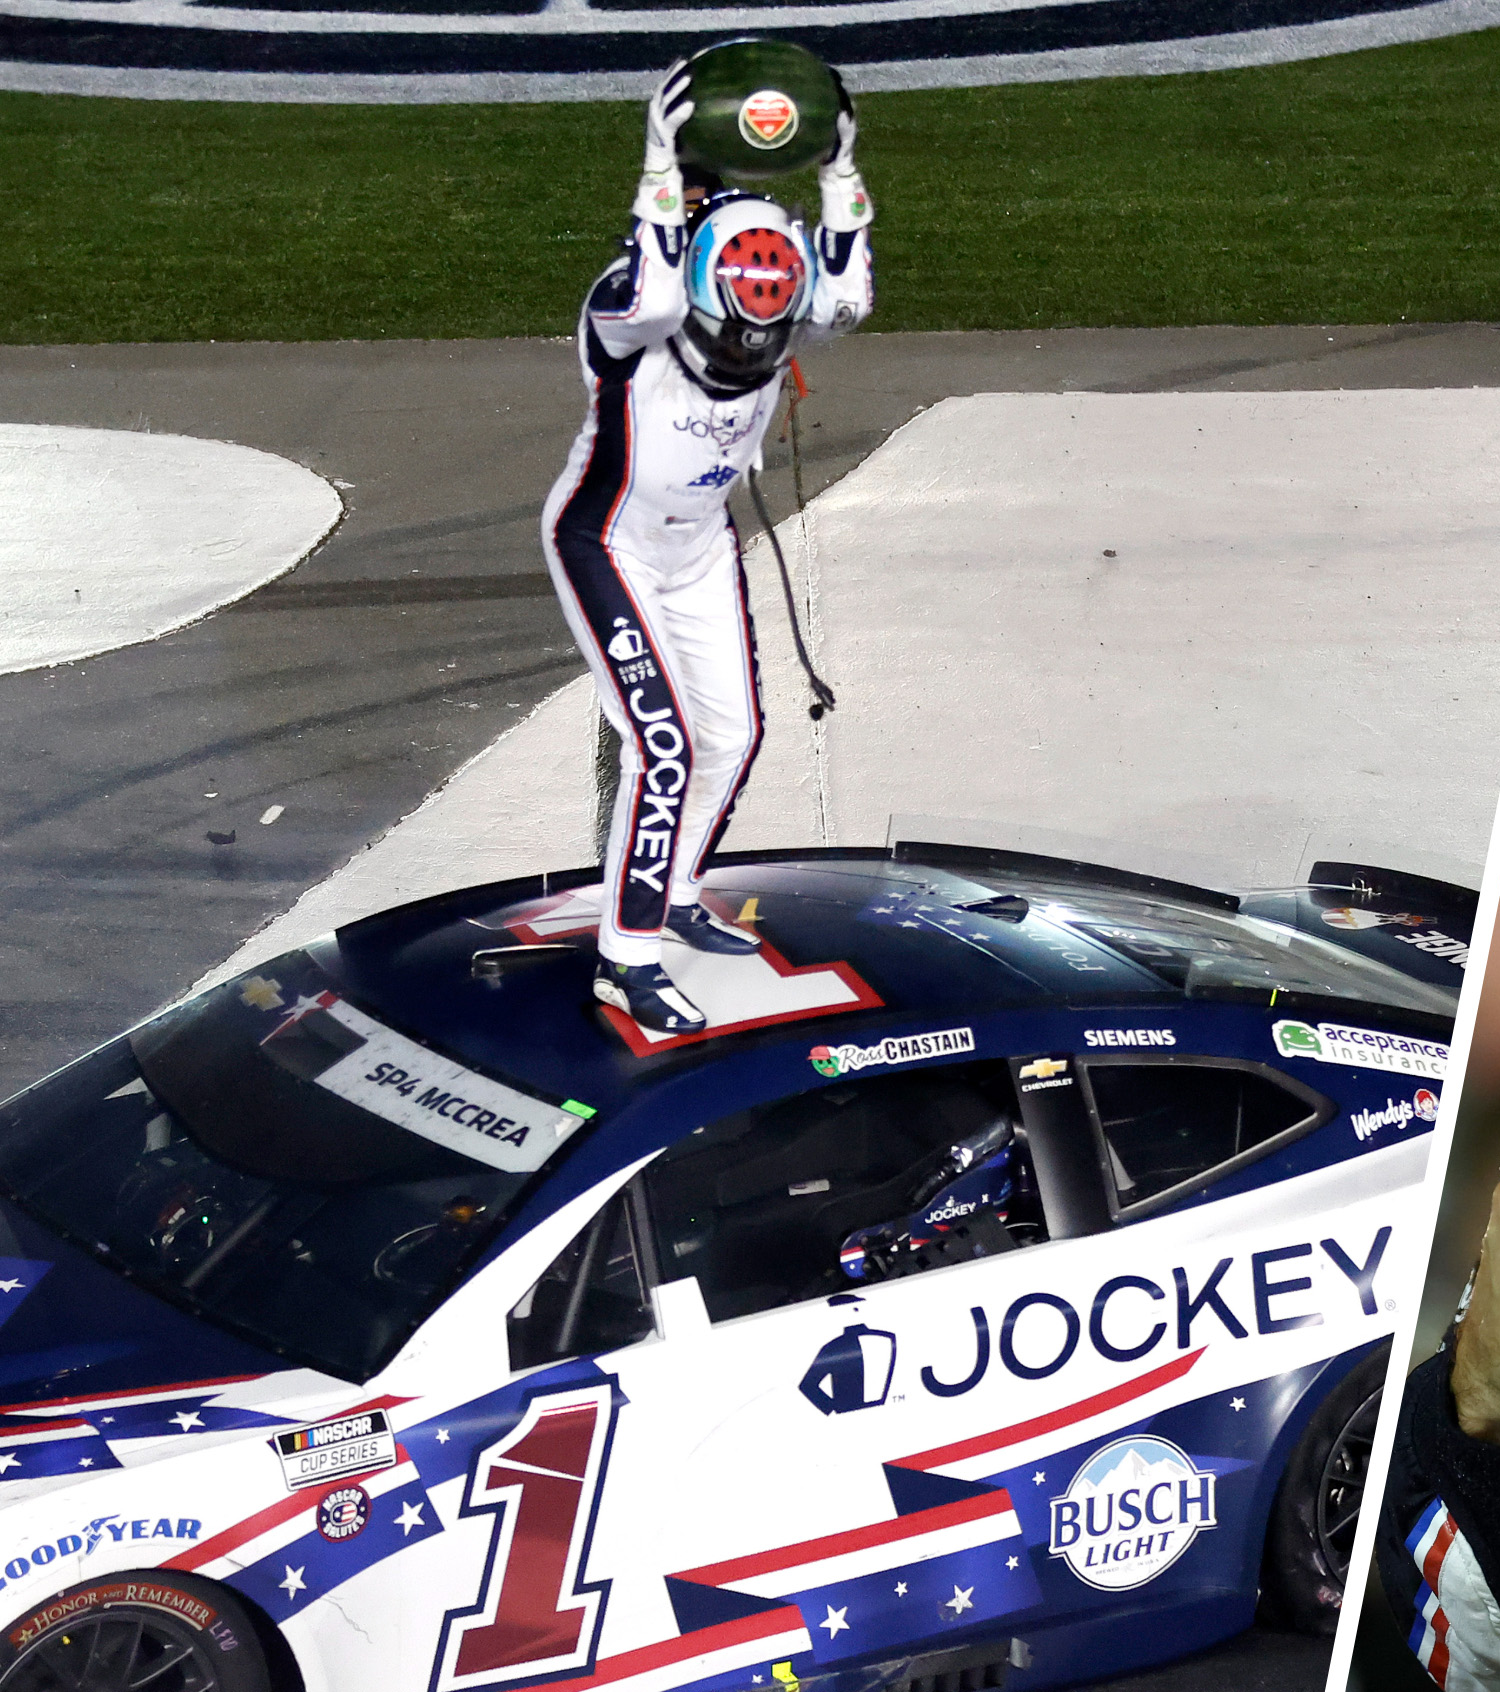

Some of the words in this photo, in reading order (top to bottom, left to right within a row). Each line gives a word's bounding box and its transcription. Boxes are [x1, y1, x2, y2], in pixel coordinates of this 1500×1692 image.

[618, 659, 652, 675] SINCE
[621, 667, 657, 685] 1876
[629, 688, 687, 893] JOCKEY
[1395, 931, 1471, 970] NGE
[884, 1031, 970, 1061] CHASTAIN
[1084, 1029, 1176, 1046] SIEMENS
[1325, 1027, 1449, 1060] acceptance
[1331, 1043, 1447, 1075] insuranc
[1021, 1077, 1074, 1093] CHEVROLET
[365, 1062, 421, 1097] SP4
[415, 1087, 531, 1148] MCCREA
[1351, 1098, 1414, 1141] Wendy's
[925, 1202, 977, 1224] JOCKEY
[920, 1226, 1393, 1398] JOCKEY
[313, 1416, 372, 1447] NASCAR
[301, 1453, 328, 1473] CUP
[330, 1441, 378, 1466] SERIES
[321, 1488, 364, 1513] NASCAR
[1053, 1476, 1211, 1549] BUSCH
[437, 1383, 614, 1691] 1
[1084, 1530, 1175, 1568] LIGHT
[34, 1591, 100, 1632] HONOR
[124, 1584, 210, 1625] REMEMBER
